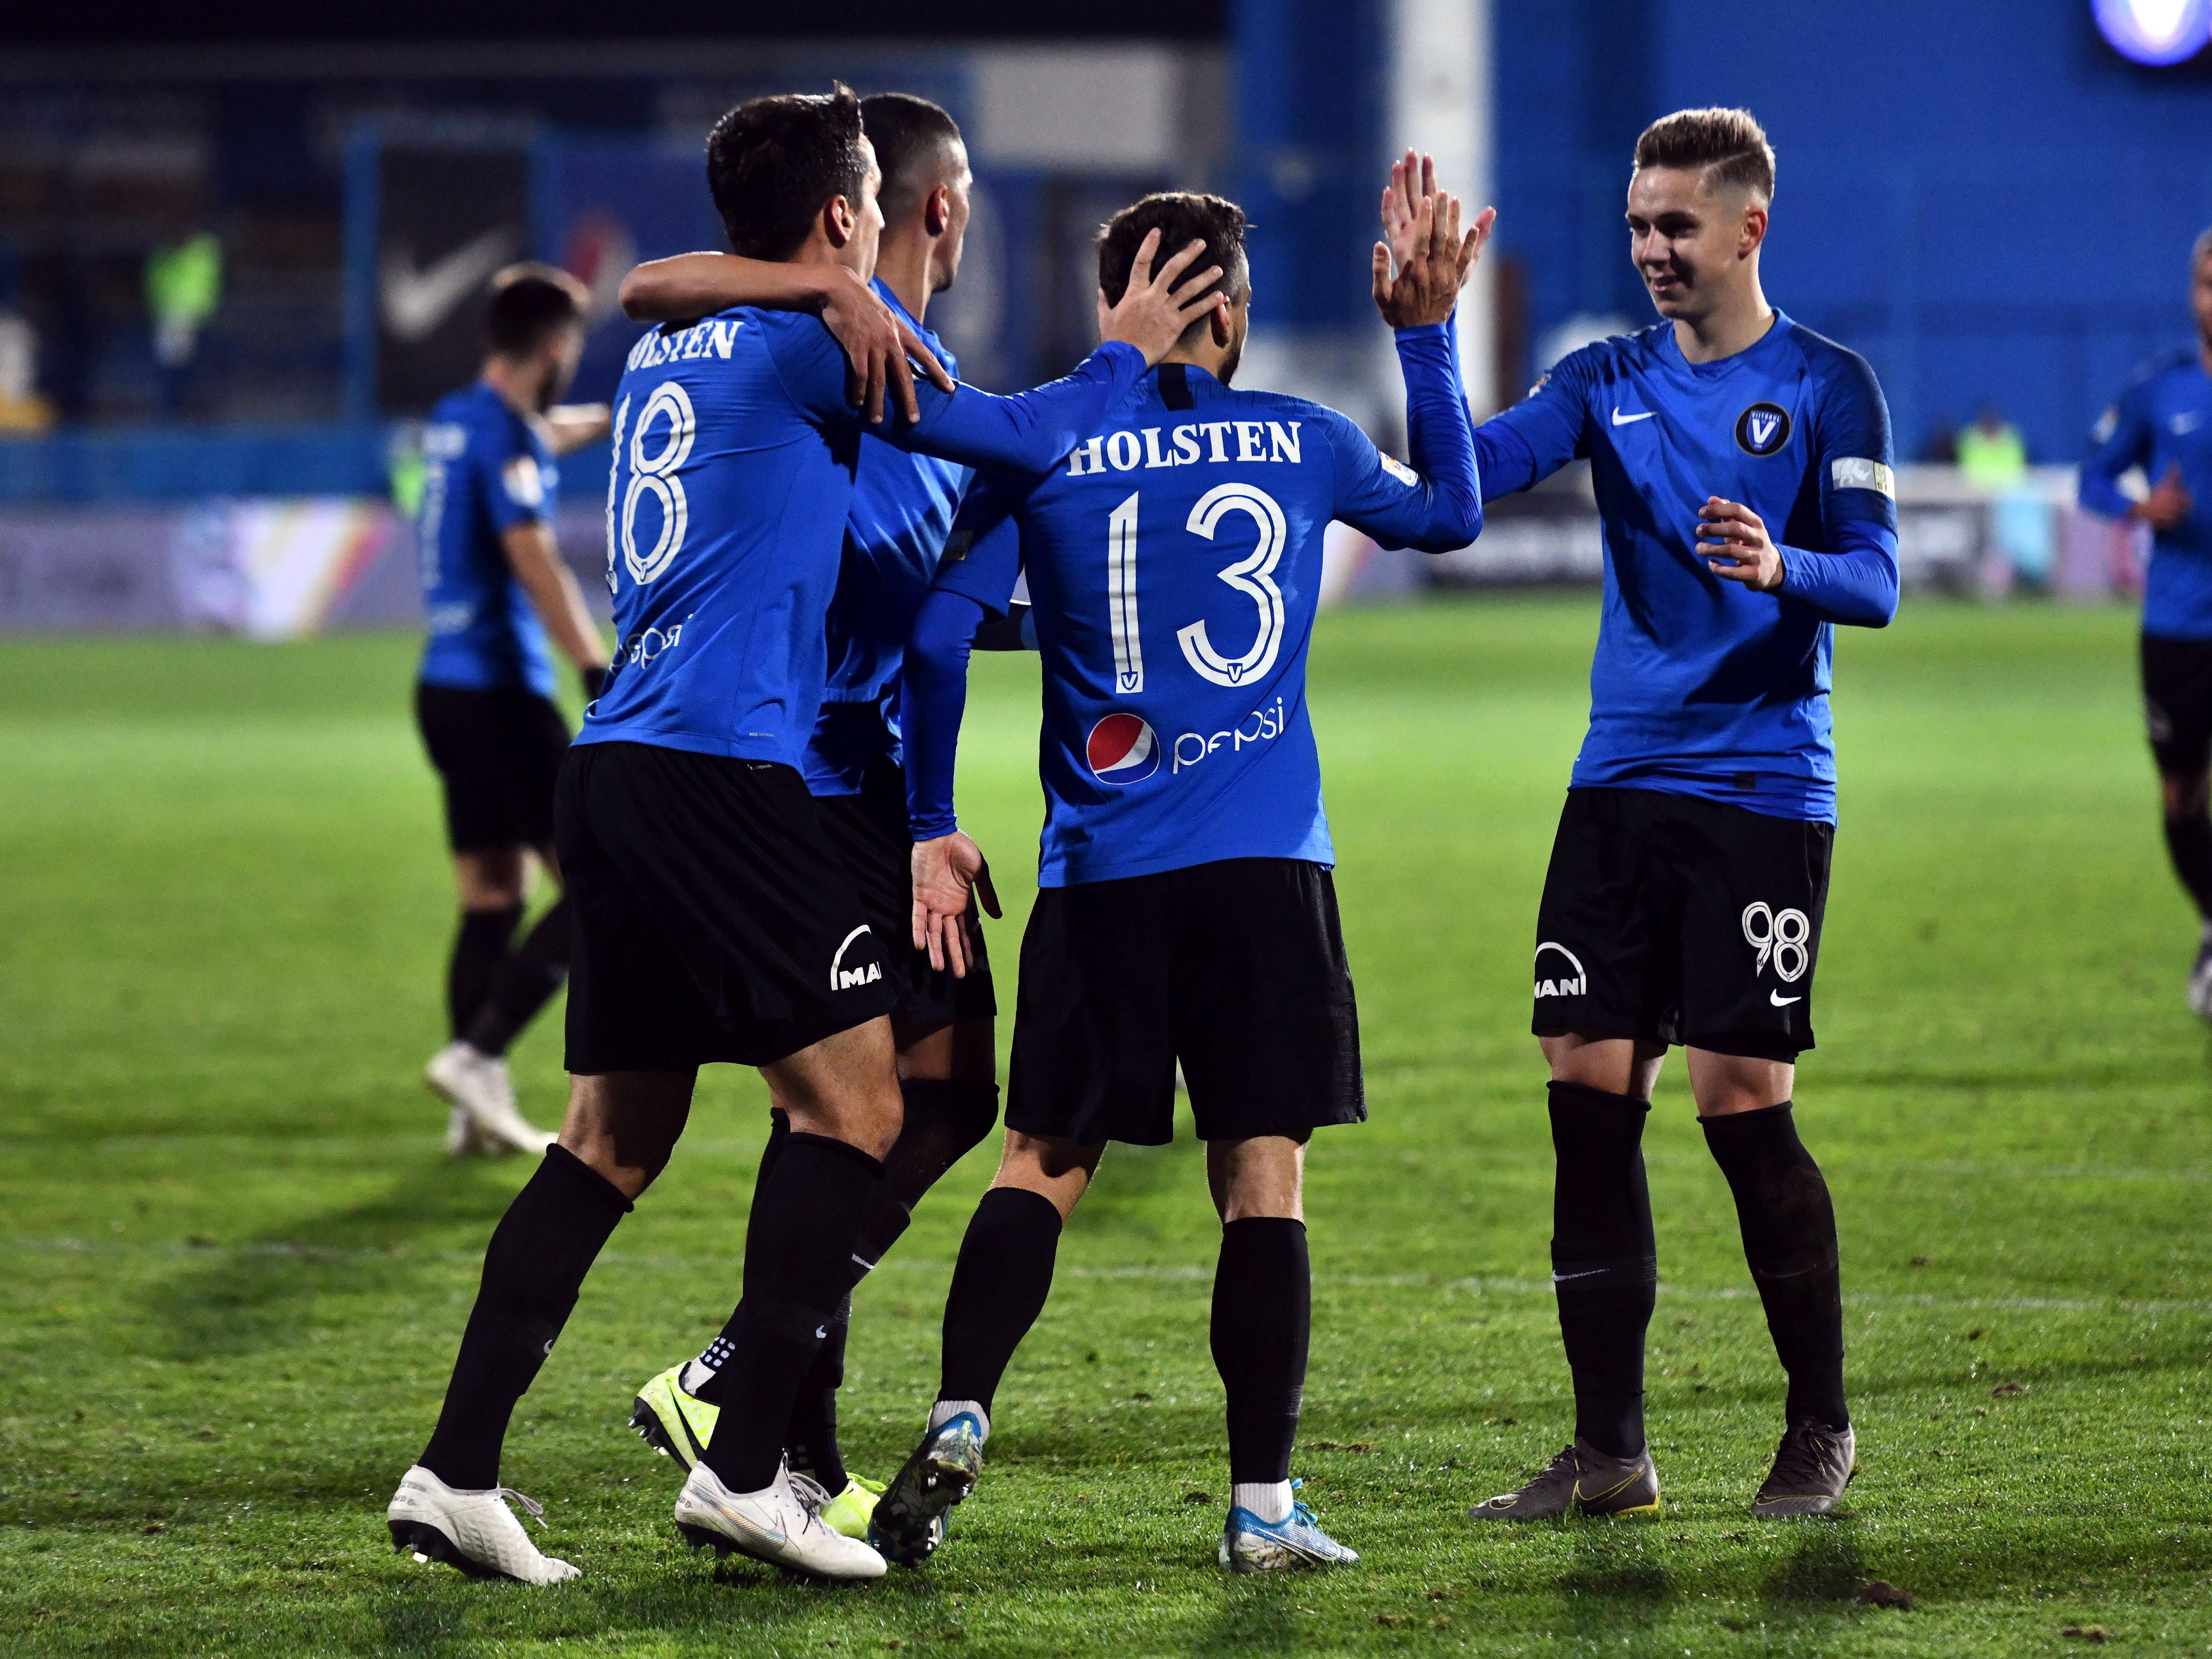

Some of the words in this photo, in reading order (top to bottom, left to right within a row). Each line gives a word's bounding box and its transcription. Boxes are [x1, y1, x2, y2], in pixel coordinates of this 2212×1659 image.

[627, 320, 745, 371] OLSTEN
[1066, 421, 1301, 476] HOLSTEN
[1108, 482, 1287, 693] 13
[1173, 696, 1284, 774] pepsi
[1741, 901, 1810, 982] 98
[839, 961, 882, 989] MA
